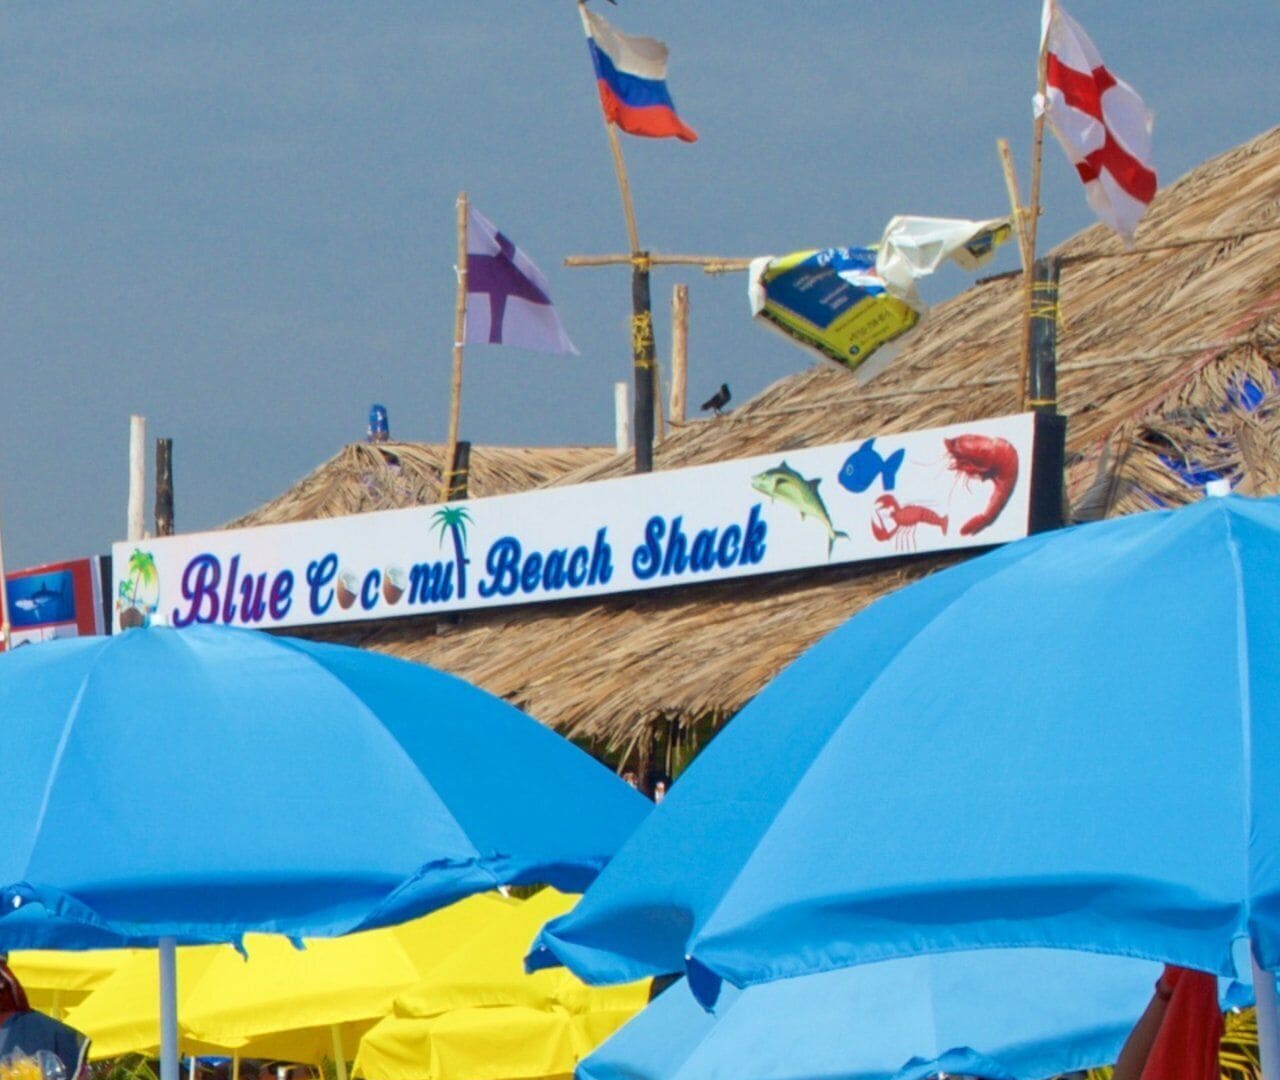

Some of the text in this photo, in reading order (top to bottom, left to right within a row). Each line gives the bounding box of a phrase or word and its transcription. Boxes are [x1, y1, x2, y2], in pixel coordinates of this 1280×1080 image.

[172, 552, 295, 628] Blue
[478, 526, 614, 599] Beach
[631, 503, 768, 580] Shack
